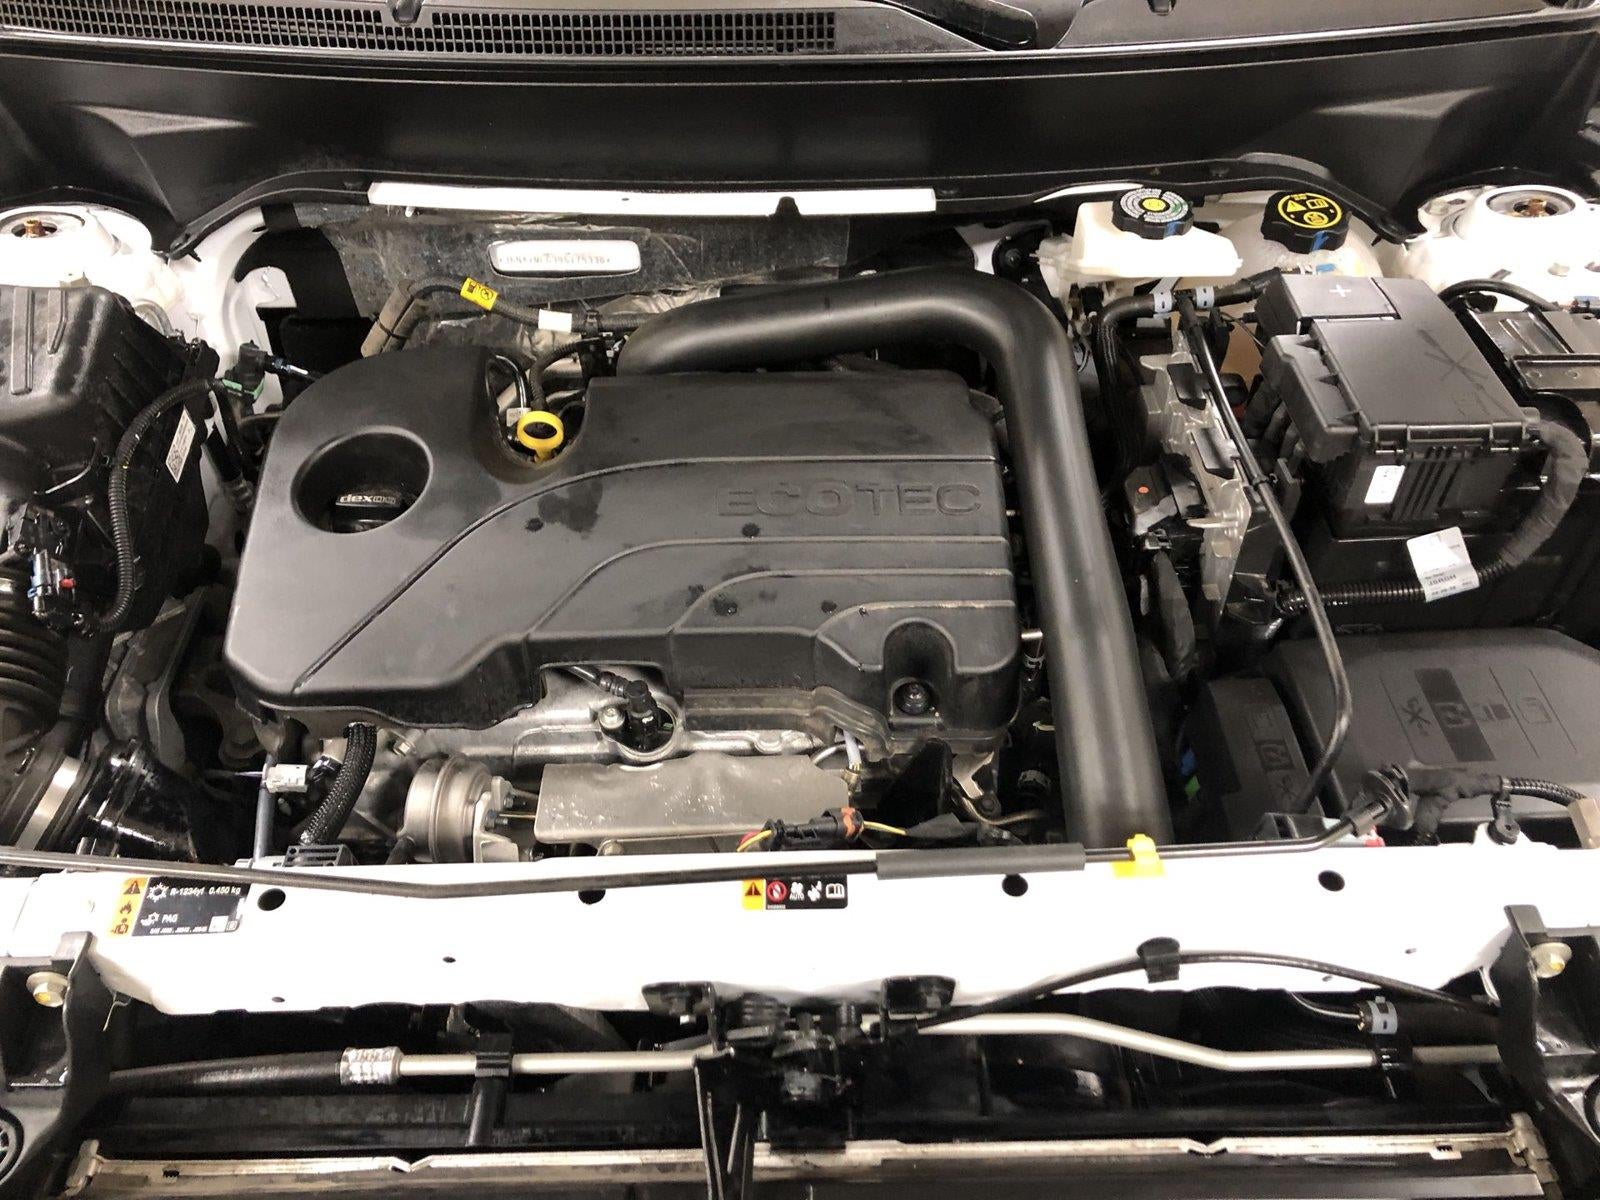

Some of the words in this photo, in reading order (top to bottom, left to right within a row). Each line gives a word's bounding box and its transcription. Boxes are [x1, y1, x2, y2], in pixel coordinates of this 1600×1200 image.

[715, 478, 982, 517] ECOTEC
[231, 886, 242, 897] kg
[789, 892, 805, 901] AUTO
